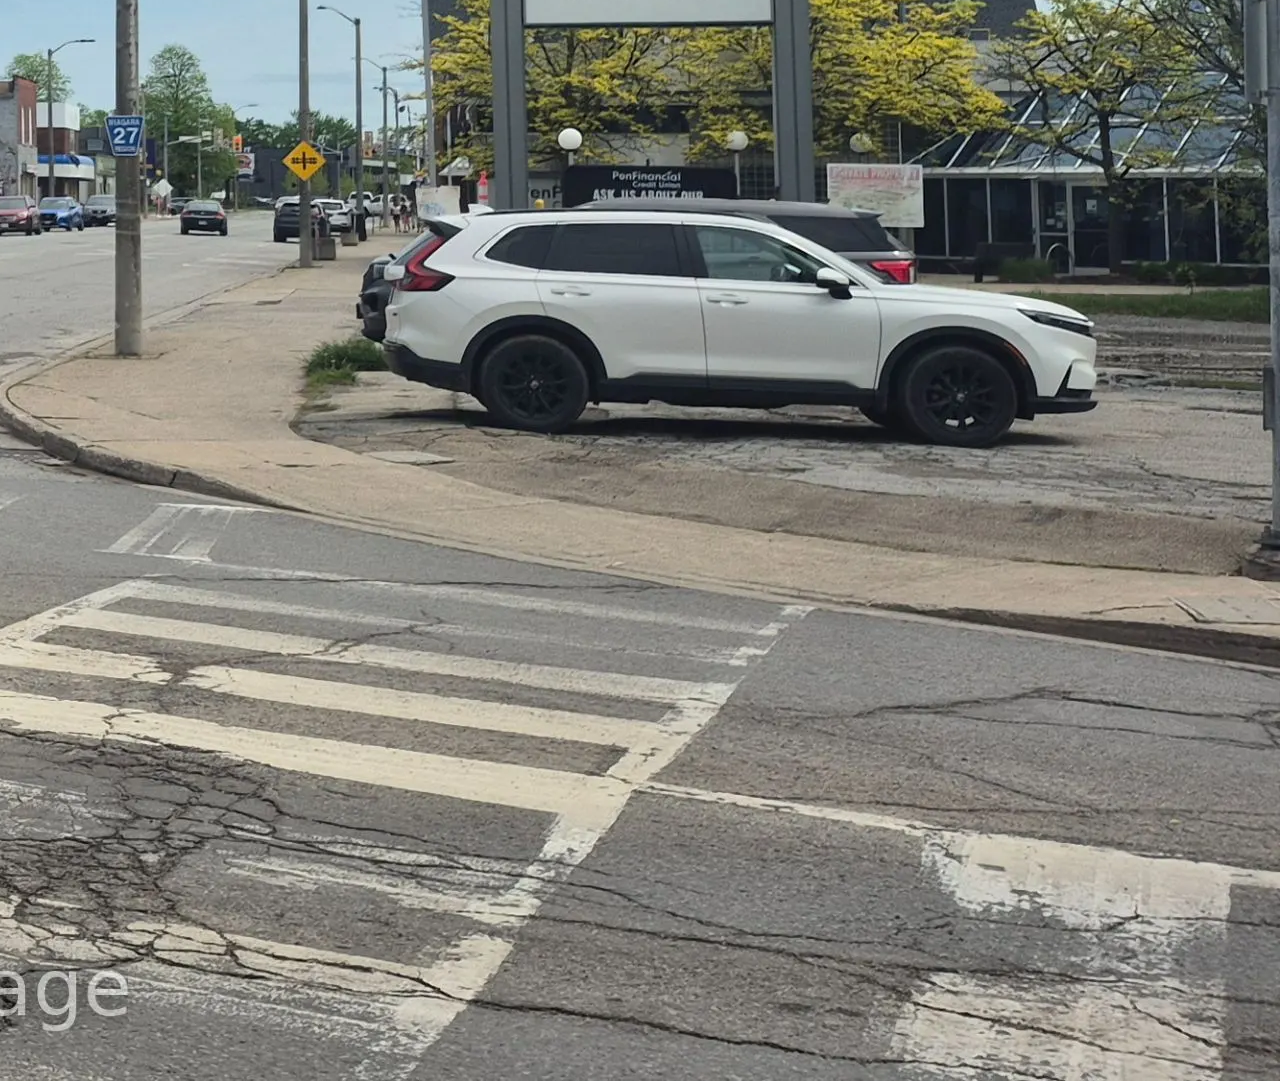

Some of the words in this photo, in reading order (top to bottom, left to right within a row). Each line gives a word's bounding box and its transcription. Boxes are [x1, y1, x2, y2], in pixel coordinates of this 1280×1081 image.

[112, 127, 139, 145] 27
[611, 170, 682, 182] PenFinancial
[632, 181, 657, 189] Credit
[657, 181, 682, 189] Union
[592, 188, 616, 200] ASK
[621, 189, 636, 199] US
[639, 190, 678, 199] ABOUT
